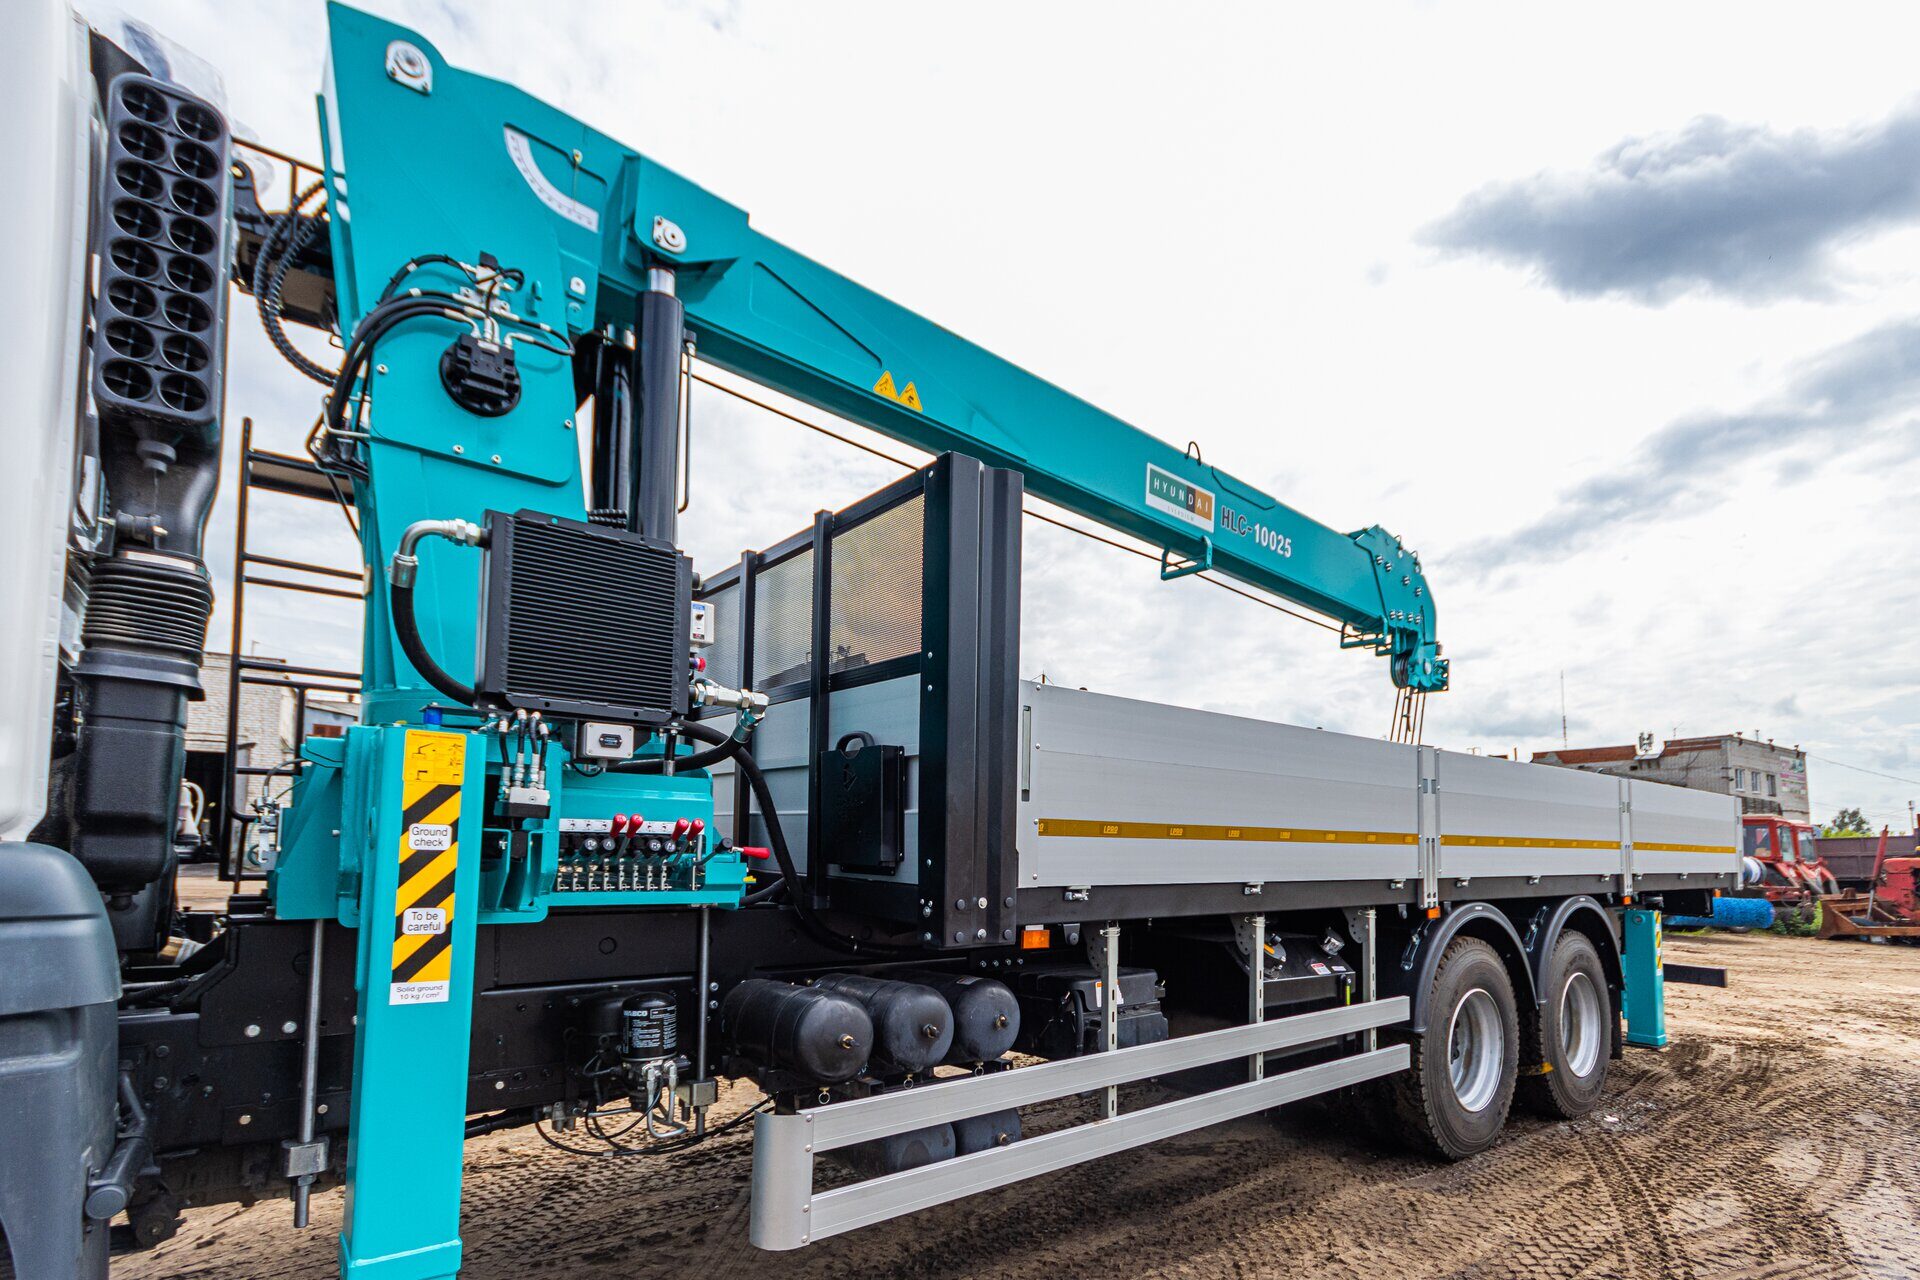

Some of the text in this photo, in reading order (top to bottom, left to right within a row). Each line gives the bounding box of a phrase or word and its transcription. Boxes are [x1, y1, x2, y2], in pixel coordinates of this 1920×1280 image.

[1153, 477, 1209, 513] HYUNDAI
[1221, 505, 1292, 558] HLC-10025
[411, 826, 448, 837] Ground
[414, 837, 444, 847] check
[411, 911, 438, 920] To be
[407, 920, 441, 932] careful
